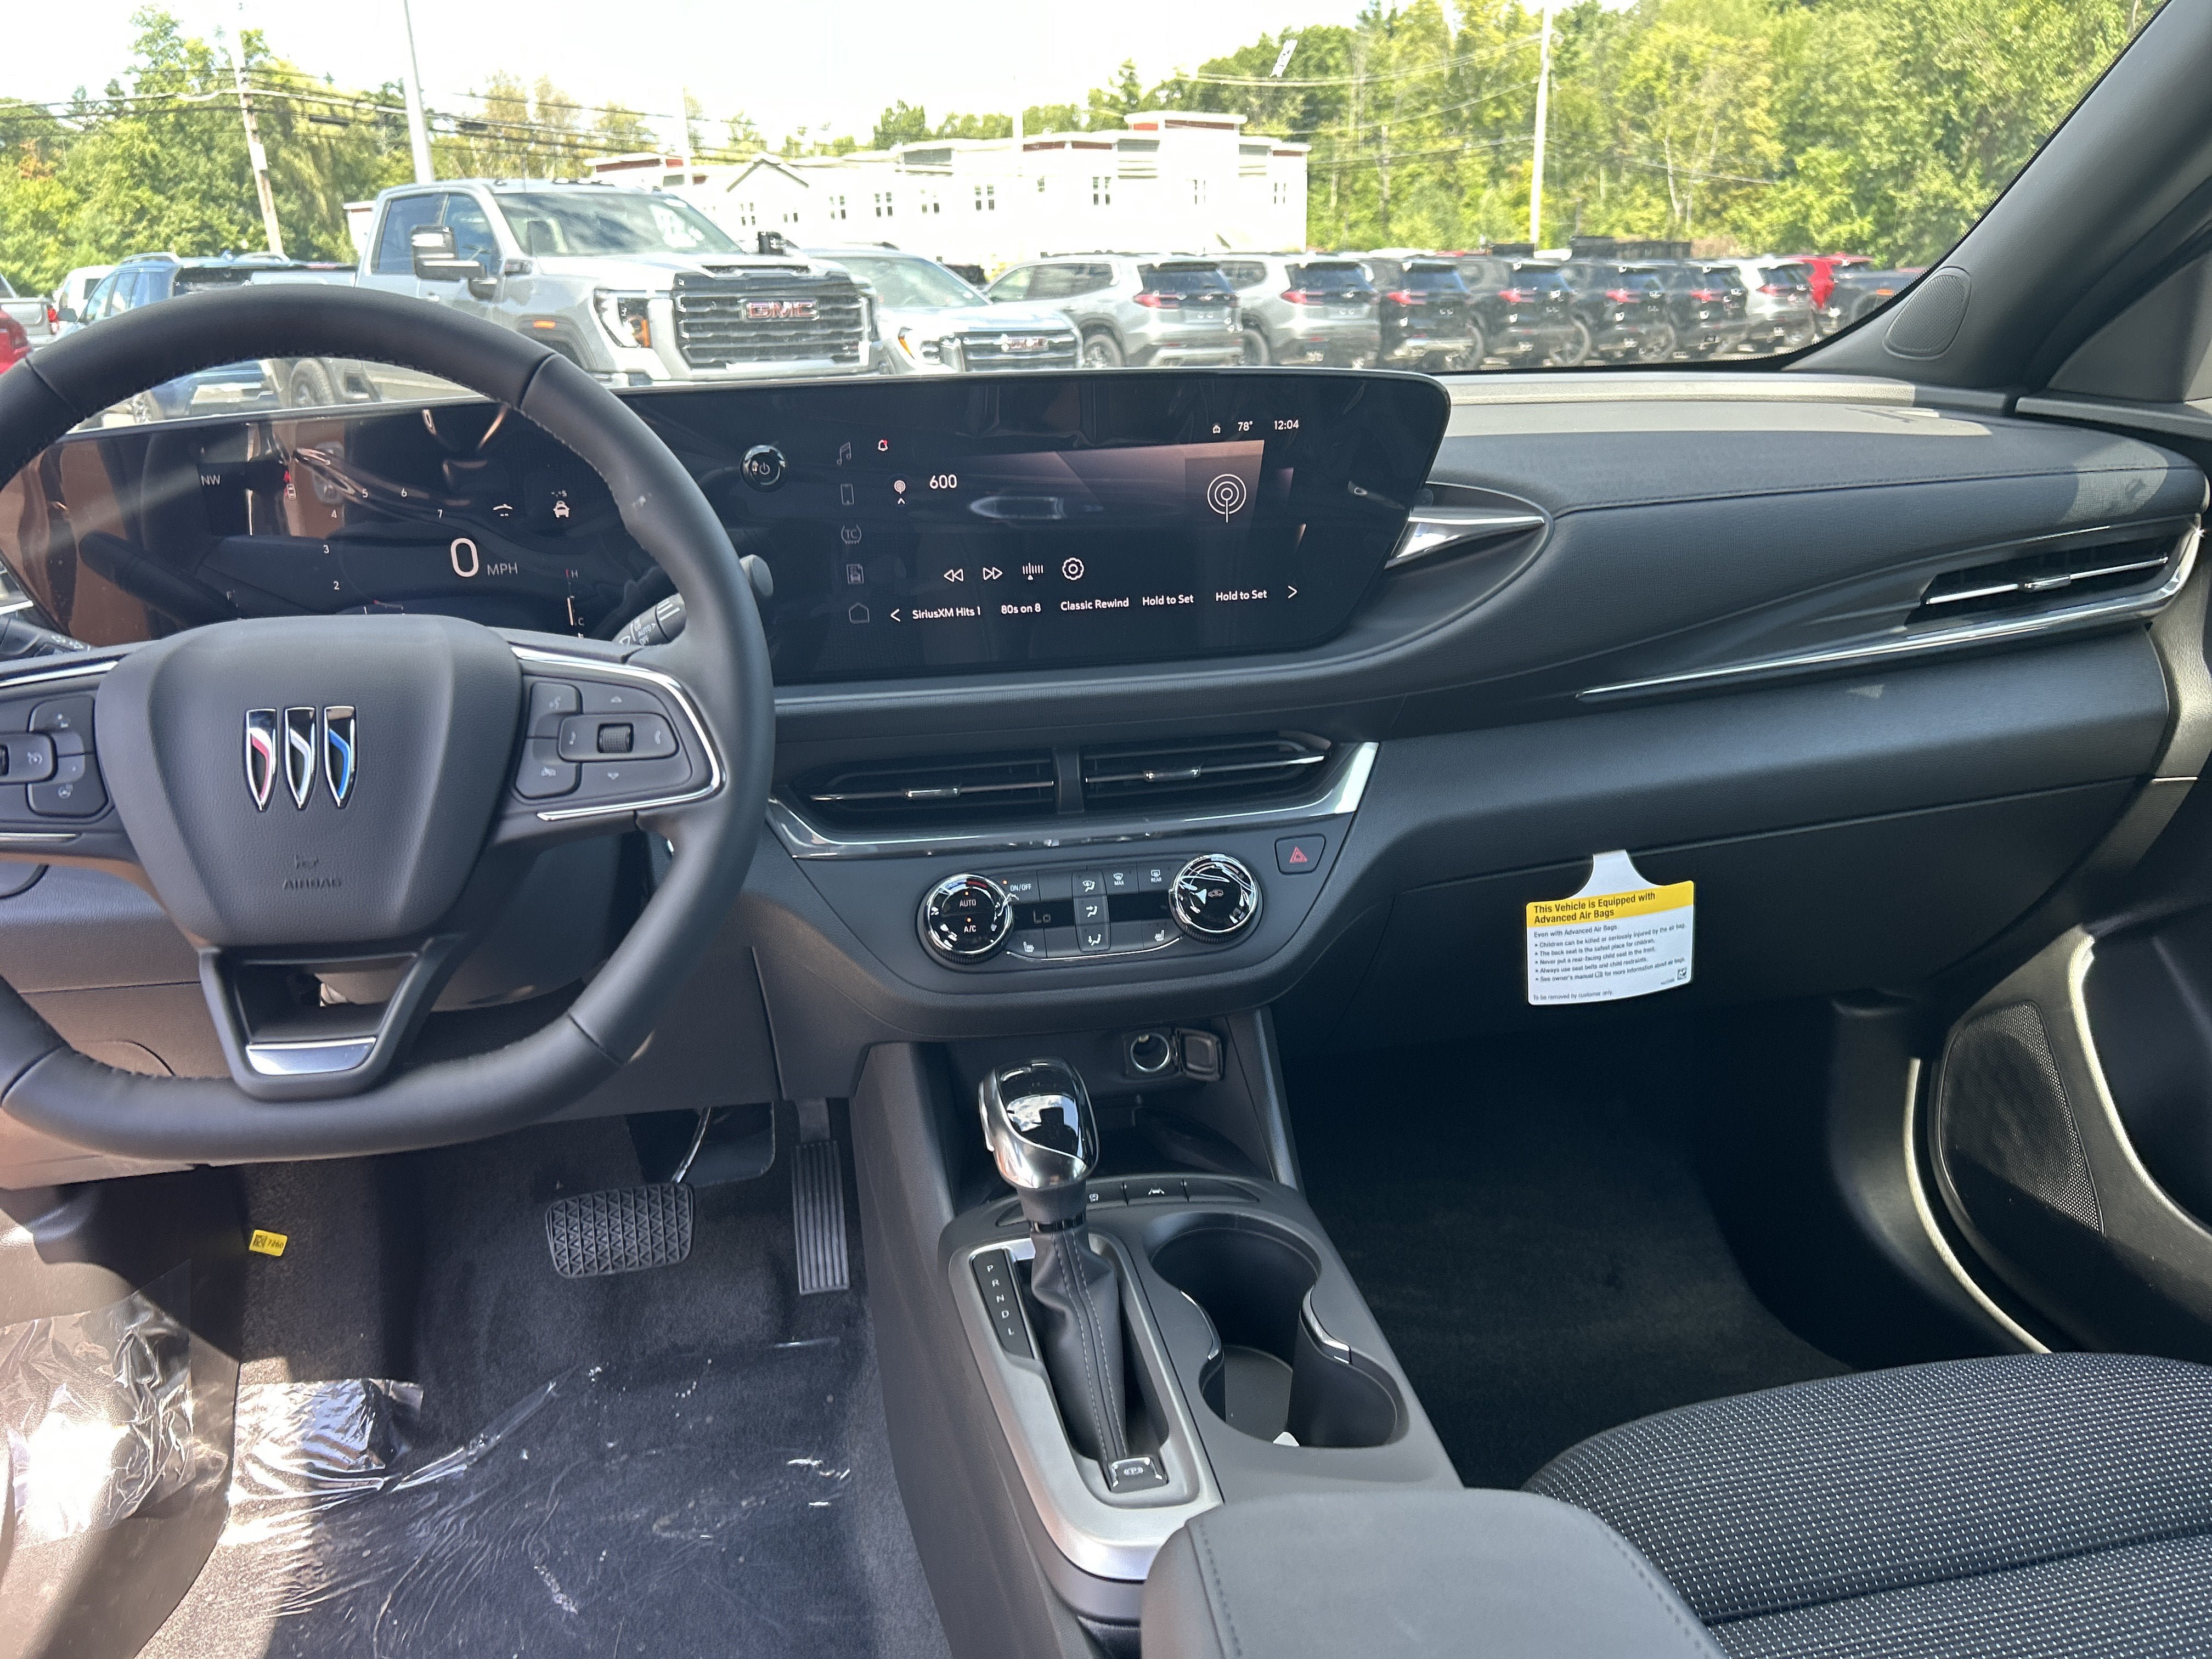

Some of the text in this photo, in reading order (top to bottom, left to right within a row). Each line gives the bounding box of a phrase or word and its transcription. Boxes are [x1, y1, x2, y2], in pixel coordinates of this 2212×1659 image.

[747, 302, 817, 318] GMC
[1274, 419, 1299, 430] 12:04
[201, 474, 221, 487] NW
[929, 474, 957, 489] 600
[362, 488, 368, 498] 5
[401, 487, 408, 498] 6
[331, 509, 337, 518] 4
[324, 544, 329, 554] 3
[450, 538, 479, 577] 0
[487, 562, 518, 576] MPH
[334, 580, 340, 590] 2
[1142, 594, 1194, 606] Hold to Set
[1216, 590, 1267, 602] Hold to Set
[1001, 603, 1041, 614] 80s on 8
[1060, 597, 1129, 611] Classic Rewind
[912, 607, 954, 619] SiriusXM
[956, 606, 975, 617] Hits
[1010, 883, 1032, 891] ON/OFF
[960, 899, 977, 907] AUTO
[1534, 905, 1553, 914] This
[1555, 901, 1585, 912] Vehicle
[1598, 894, 1635, 907] Equipped
[1638, 891, 1655, 901] with
[1534, 909, 1615, 924] Advanced Air Bags
[1564, 927, 1592, 935] Advanced
[1609, 933, 1632, 941] seriously
[1634, 929, 1651, 938] injured
[992, 1279, 1000, 1287] R
[996, 1294, 1005, 1304] N
[1001, 1310, 1009, 1319] D
[1008, 1328, 1014, 1336] L
